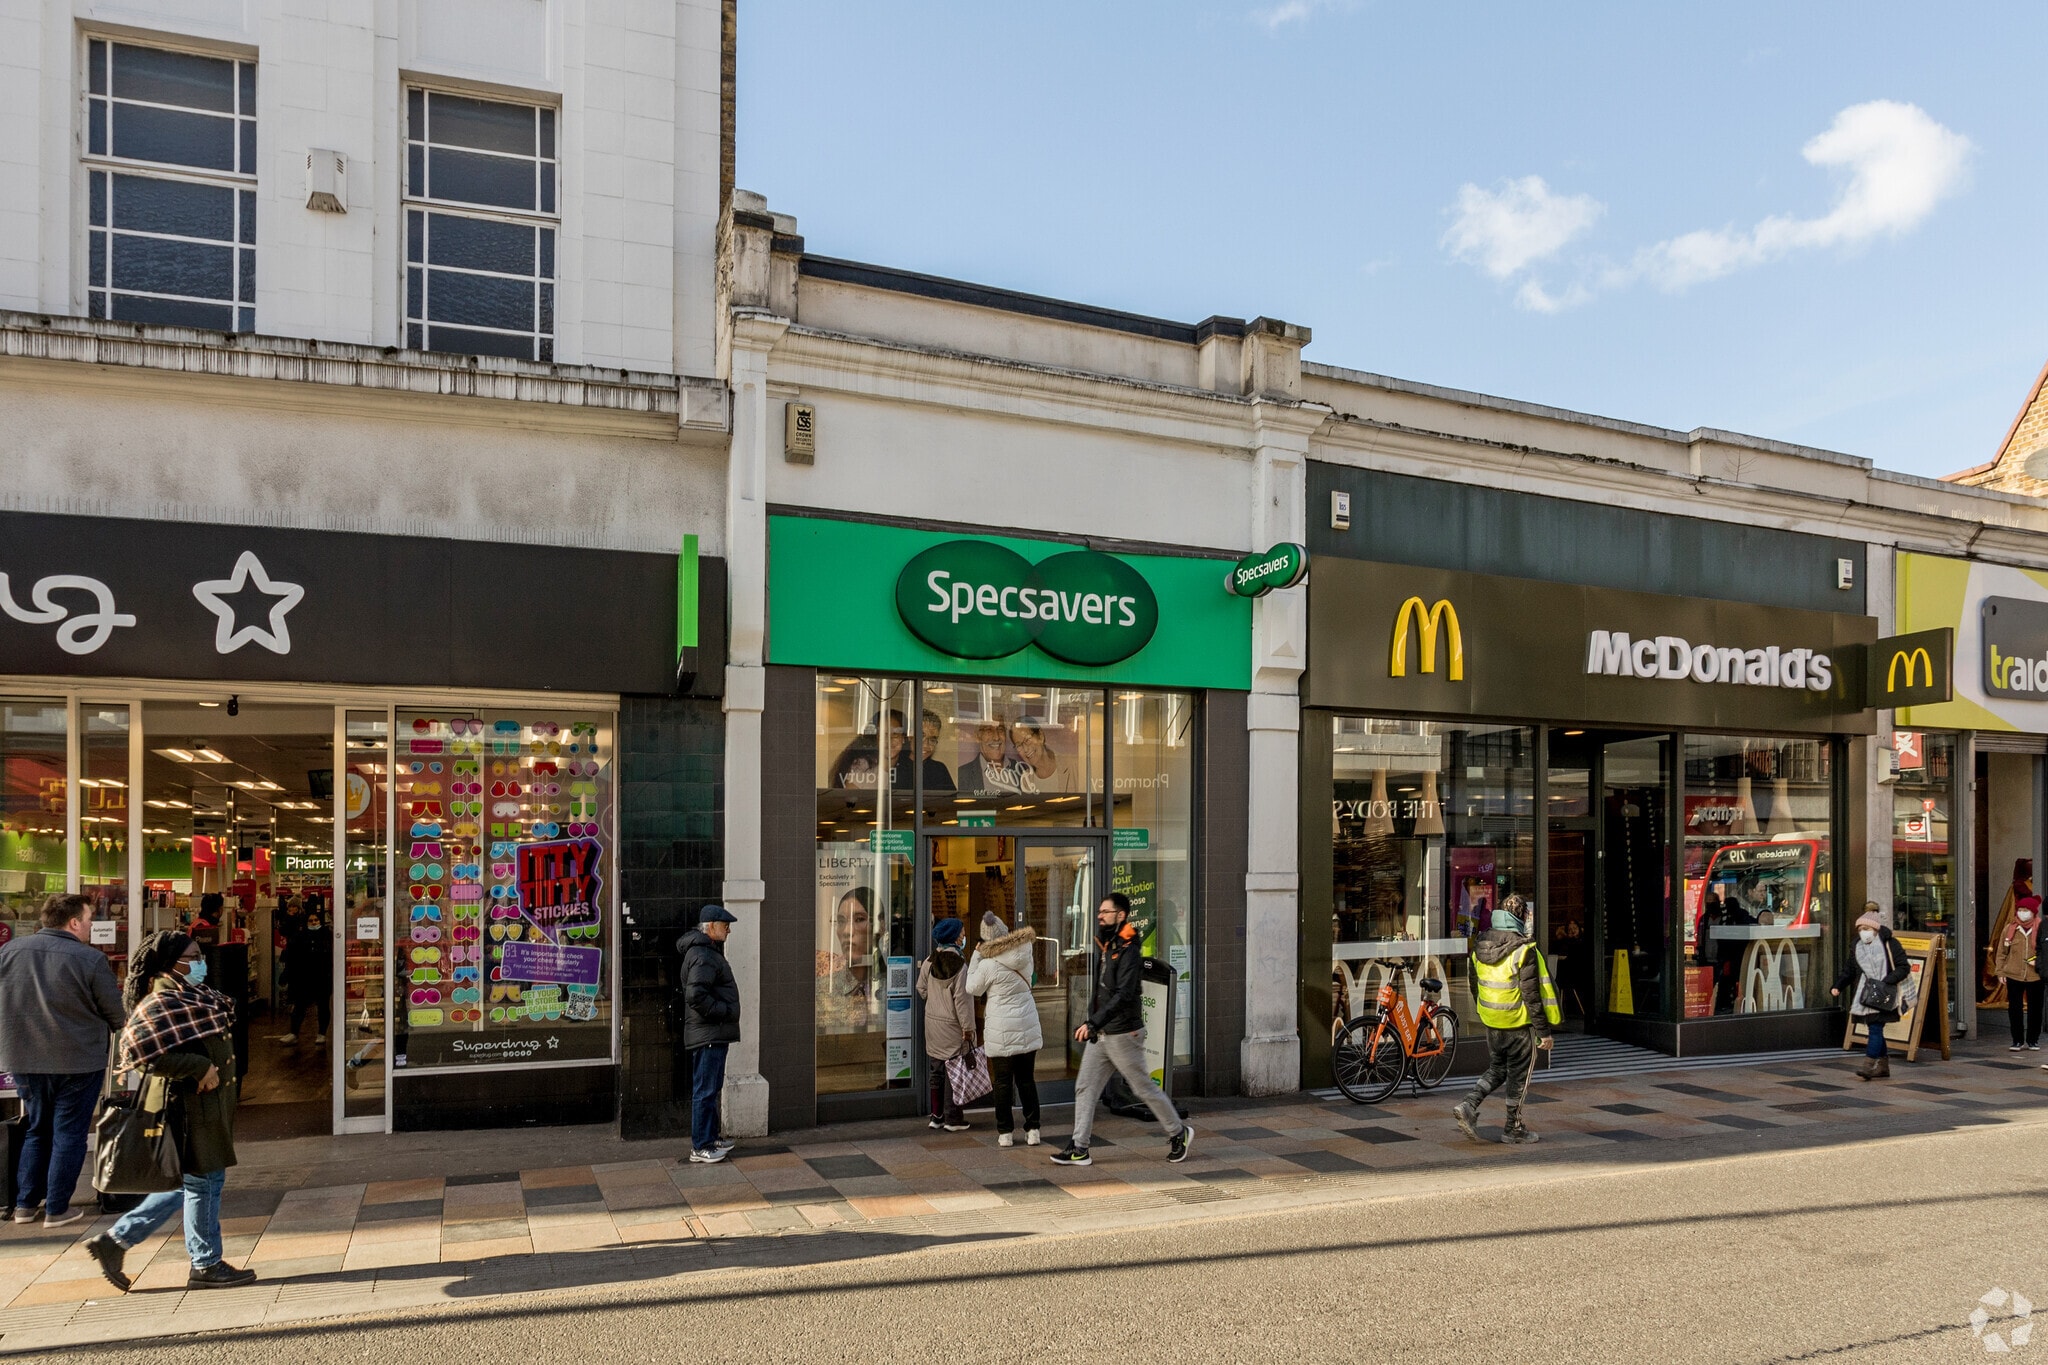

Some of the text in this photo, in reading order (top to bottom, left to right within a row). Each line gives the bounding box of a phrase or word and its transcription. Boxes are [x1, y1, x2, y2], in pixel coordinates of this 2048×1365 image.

[1237, 555, 1289, 587] Specsavers
[927, 570, 1136, 627] Specsavers
[1587, 630, 1832, 692] McDonald's
[286, 857, 351, 870] Pharmay
[520, 841, 592, 882] ITTY
[1112, 865, 1125, 875] ng
[819, 873, 849, 881] Exclusively
[520, 875, 591, 908] TITTY
[534, 902, 589, 920] STICKIES
[531, 950, 559, 960] important
[537, 988, 561, 997] YOURS
[535, 996, 557, 1005] STORE
[528, 1004, 548, 1013] SCAN
[549, 1002, 567, 1011] HERE
[452, 1039, 542, 1052] Superdrug
